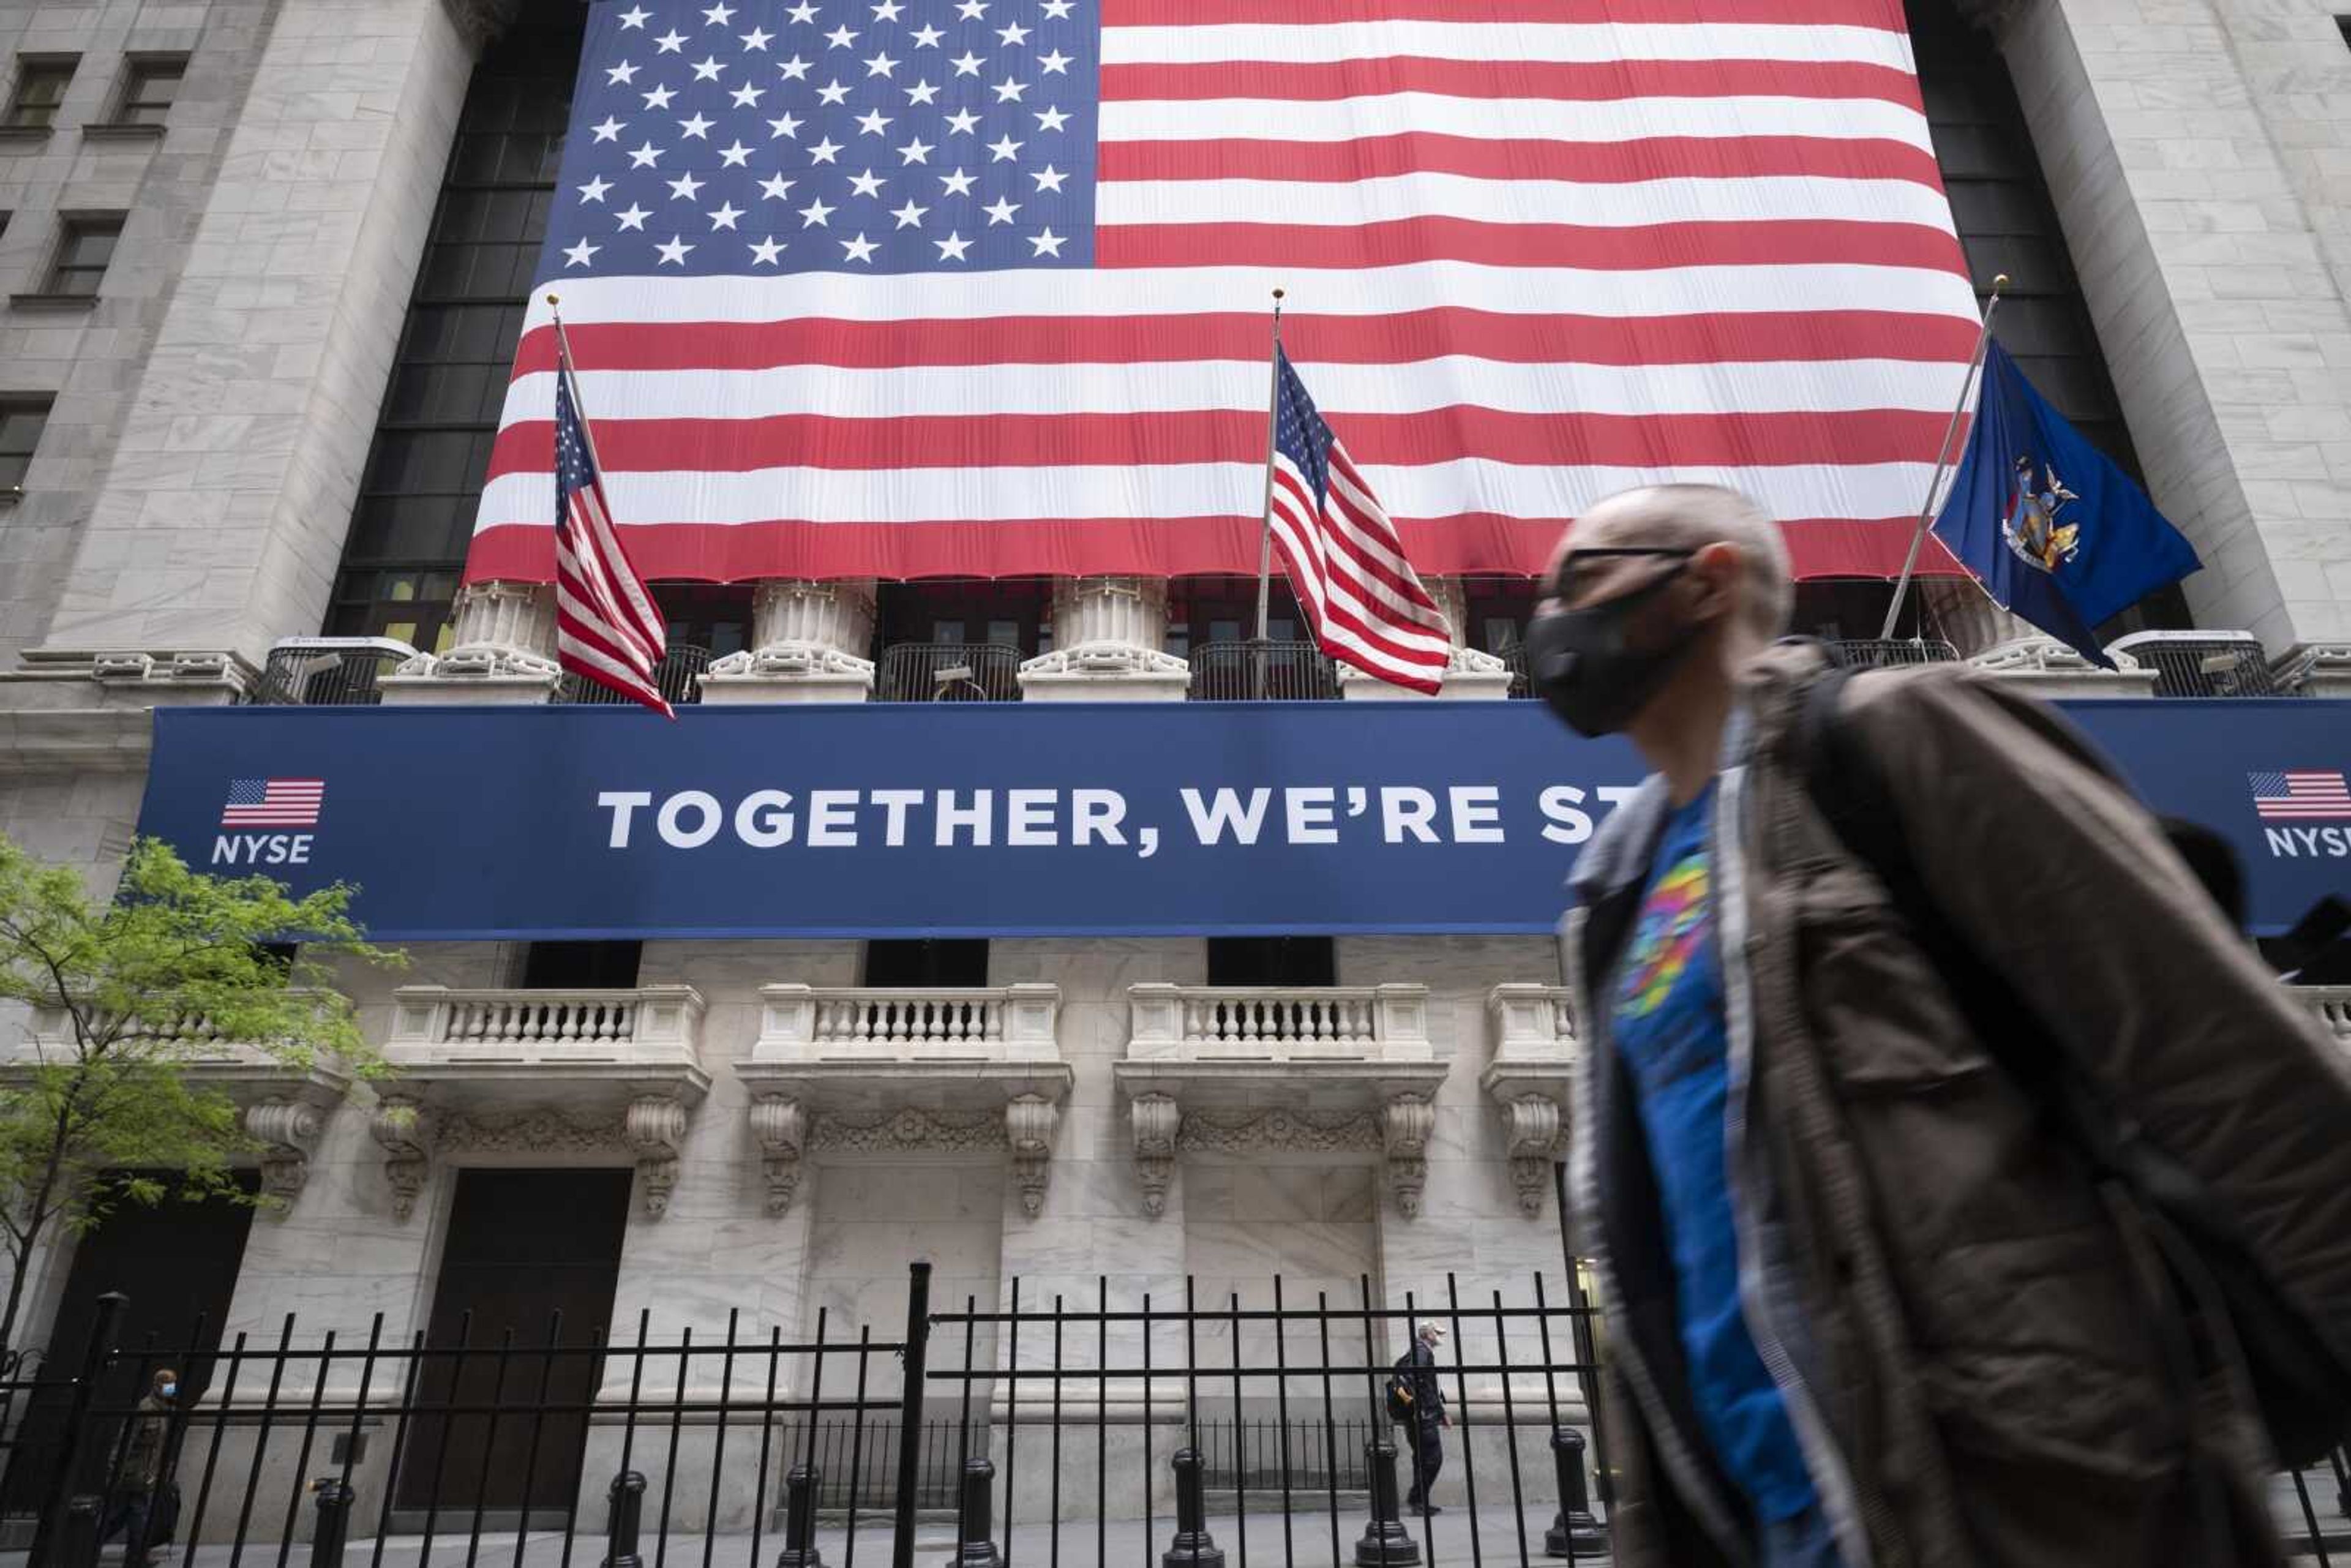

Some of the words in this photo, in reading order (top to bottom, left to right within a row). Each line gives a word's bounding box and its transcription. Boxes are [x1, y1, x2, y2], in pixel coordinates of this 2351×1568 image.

[598, 789, 1158, 858] TOGETHER,
[1180, 786, 1504, 845] WE’RE
[212, 835, 313, 863] NYSE
